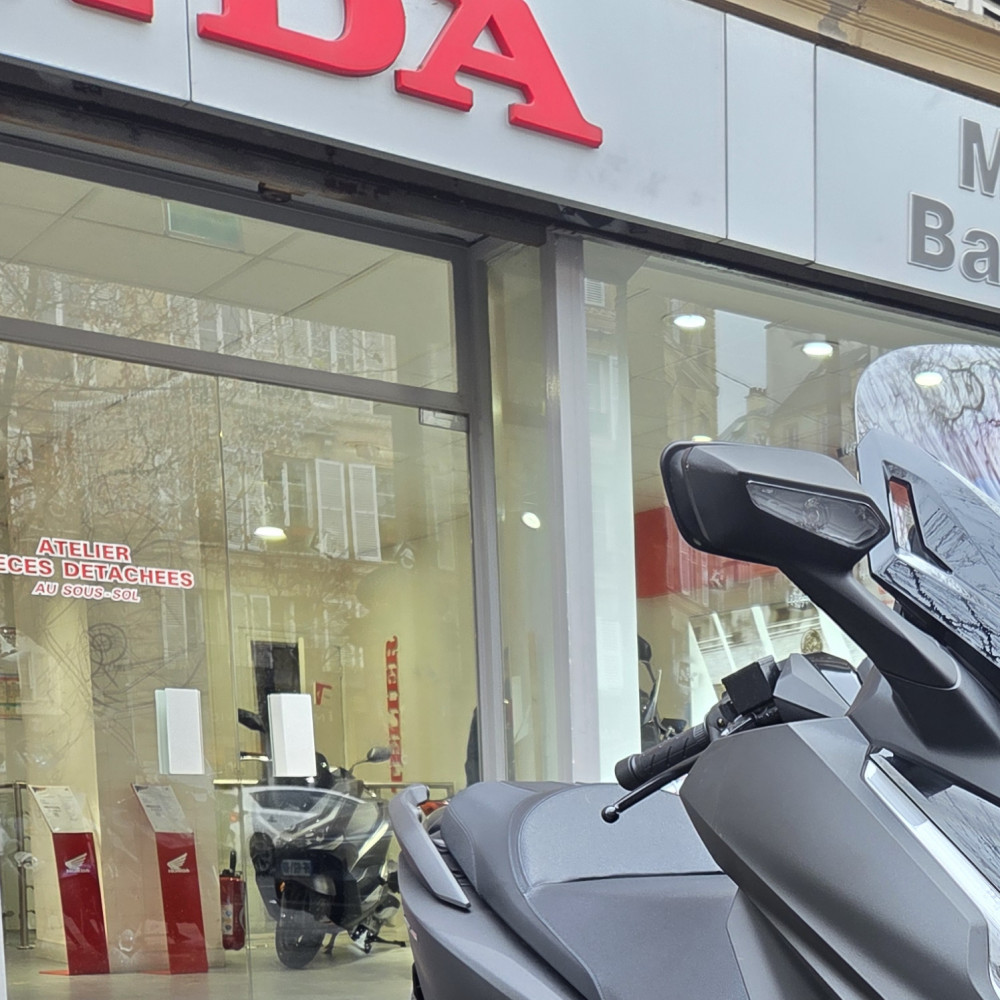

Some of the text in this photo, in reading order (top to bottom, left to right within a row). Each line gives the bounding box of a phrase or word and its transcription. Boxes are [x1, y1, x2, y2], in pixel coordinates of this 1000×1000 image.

[37, 538, 131, 562] ATELIER
[62, 561, 194, 588] DETACHEES
[33, 582, 140, 602] AU SOUS-SOL
